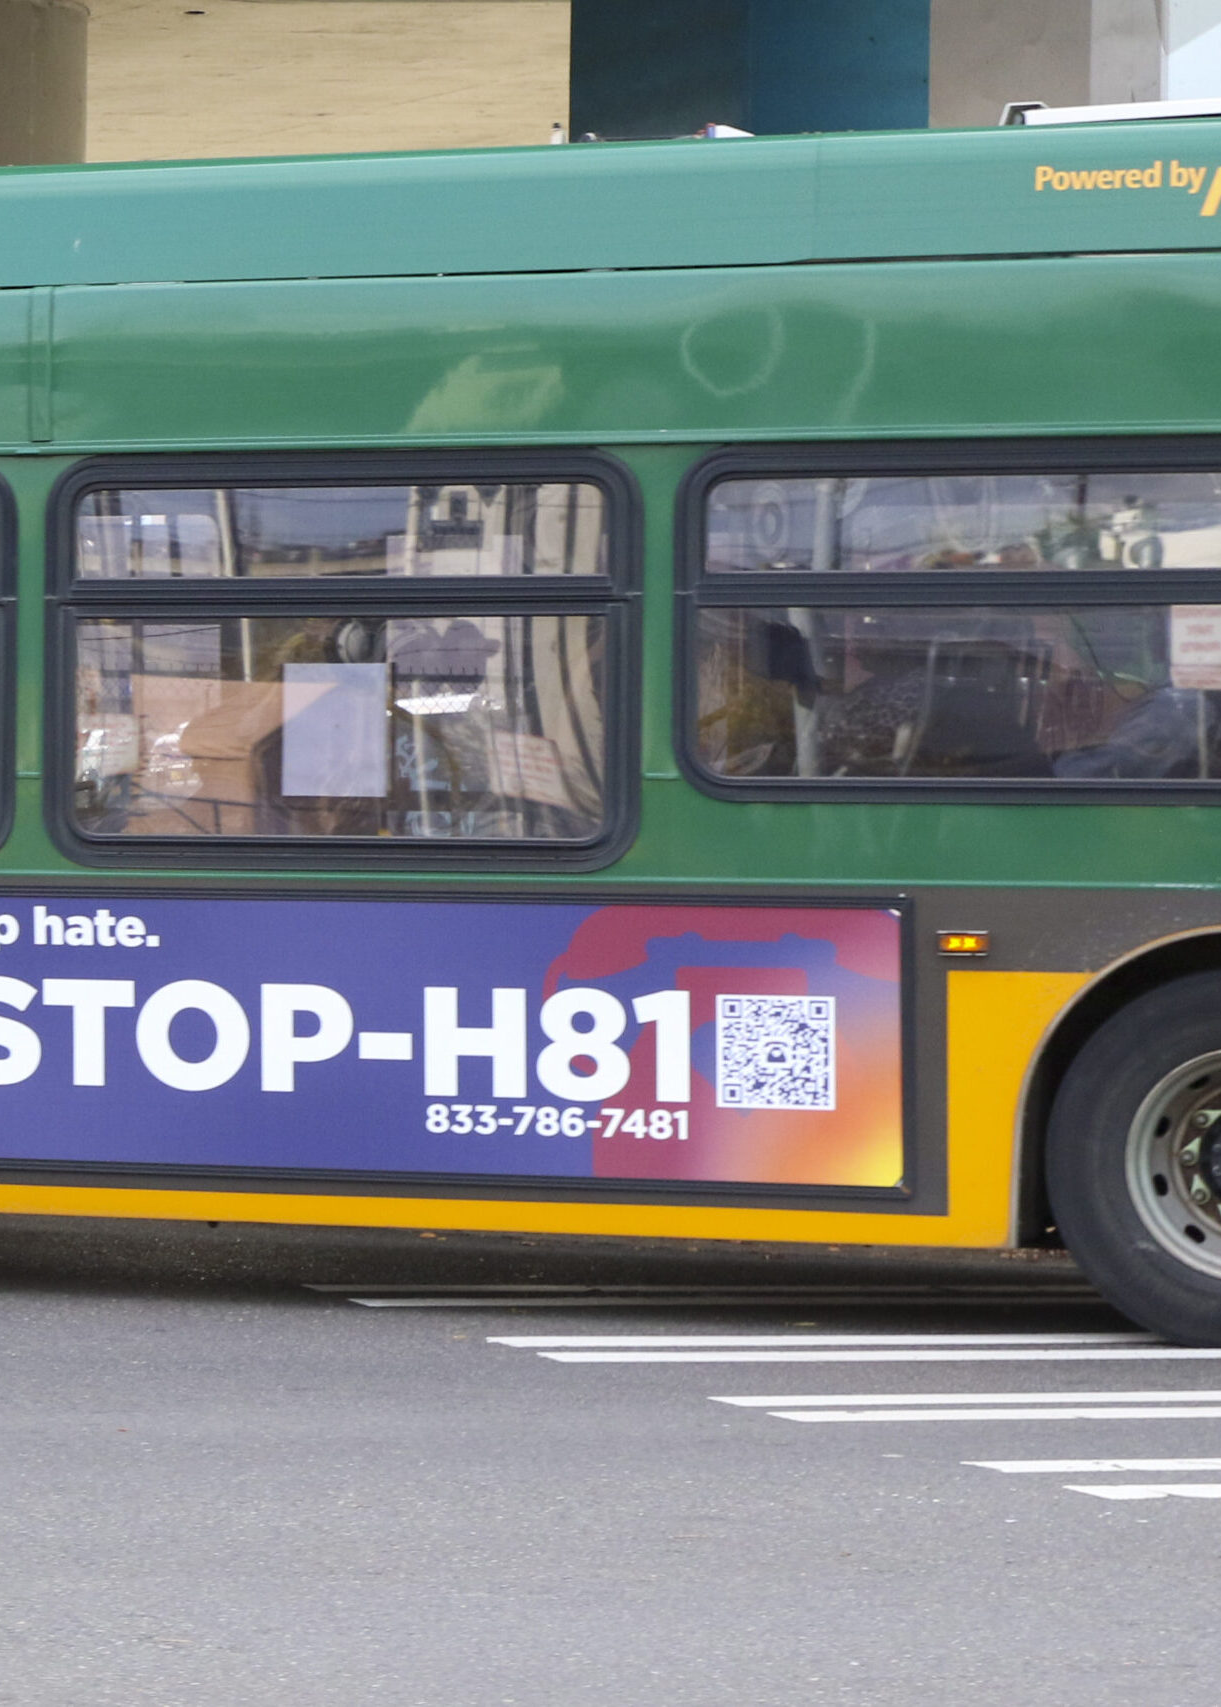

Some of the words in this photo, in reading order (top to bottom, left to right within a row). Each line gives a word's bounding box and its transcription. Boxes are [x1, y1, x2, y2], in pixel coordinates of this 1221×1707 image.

[1034, 160, 1163, 191] Powered
[1169, 159, 1207, 194] by
[33, 906, 161, 948] hate.
[425, 1103, 690, 1141] 833-786-7481
